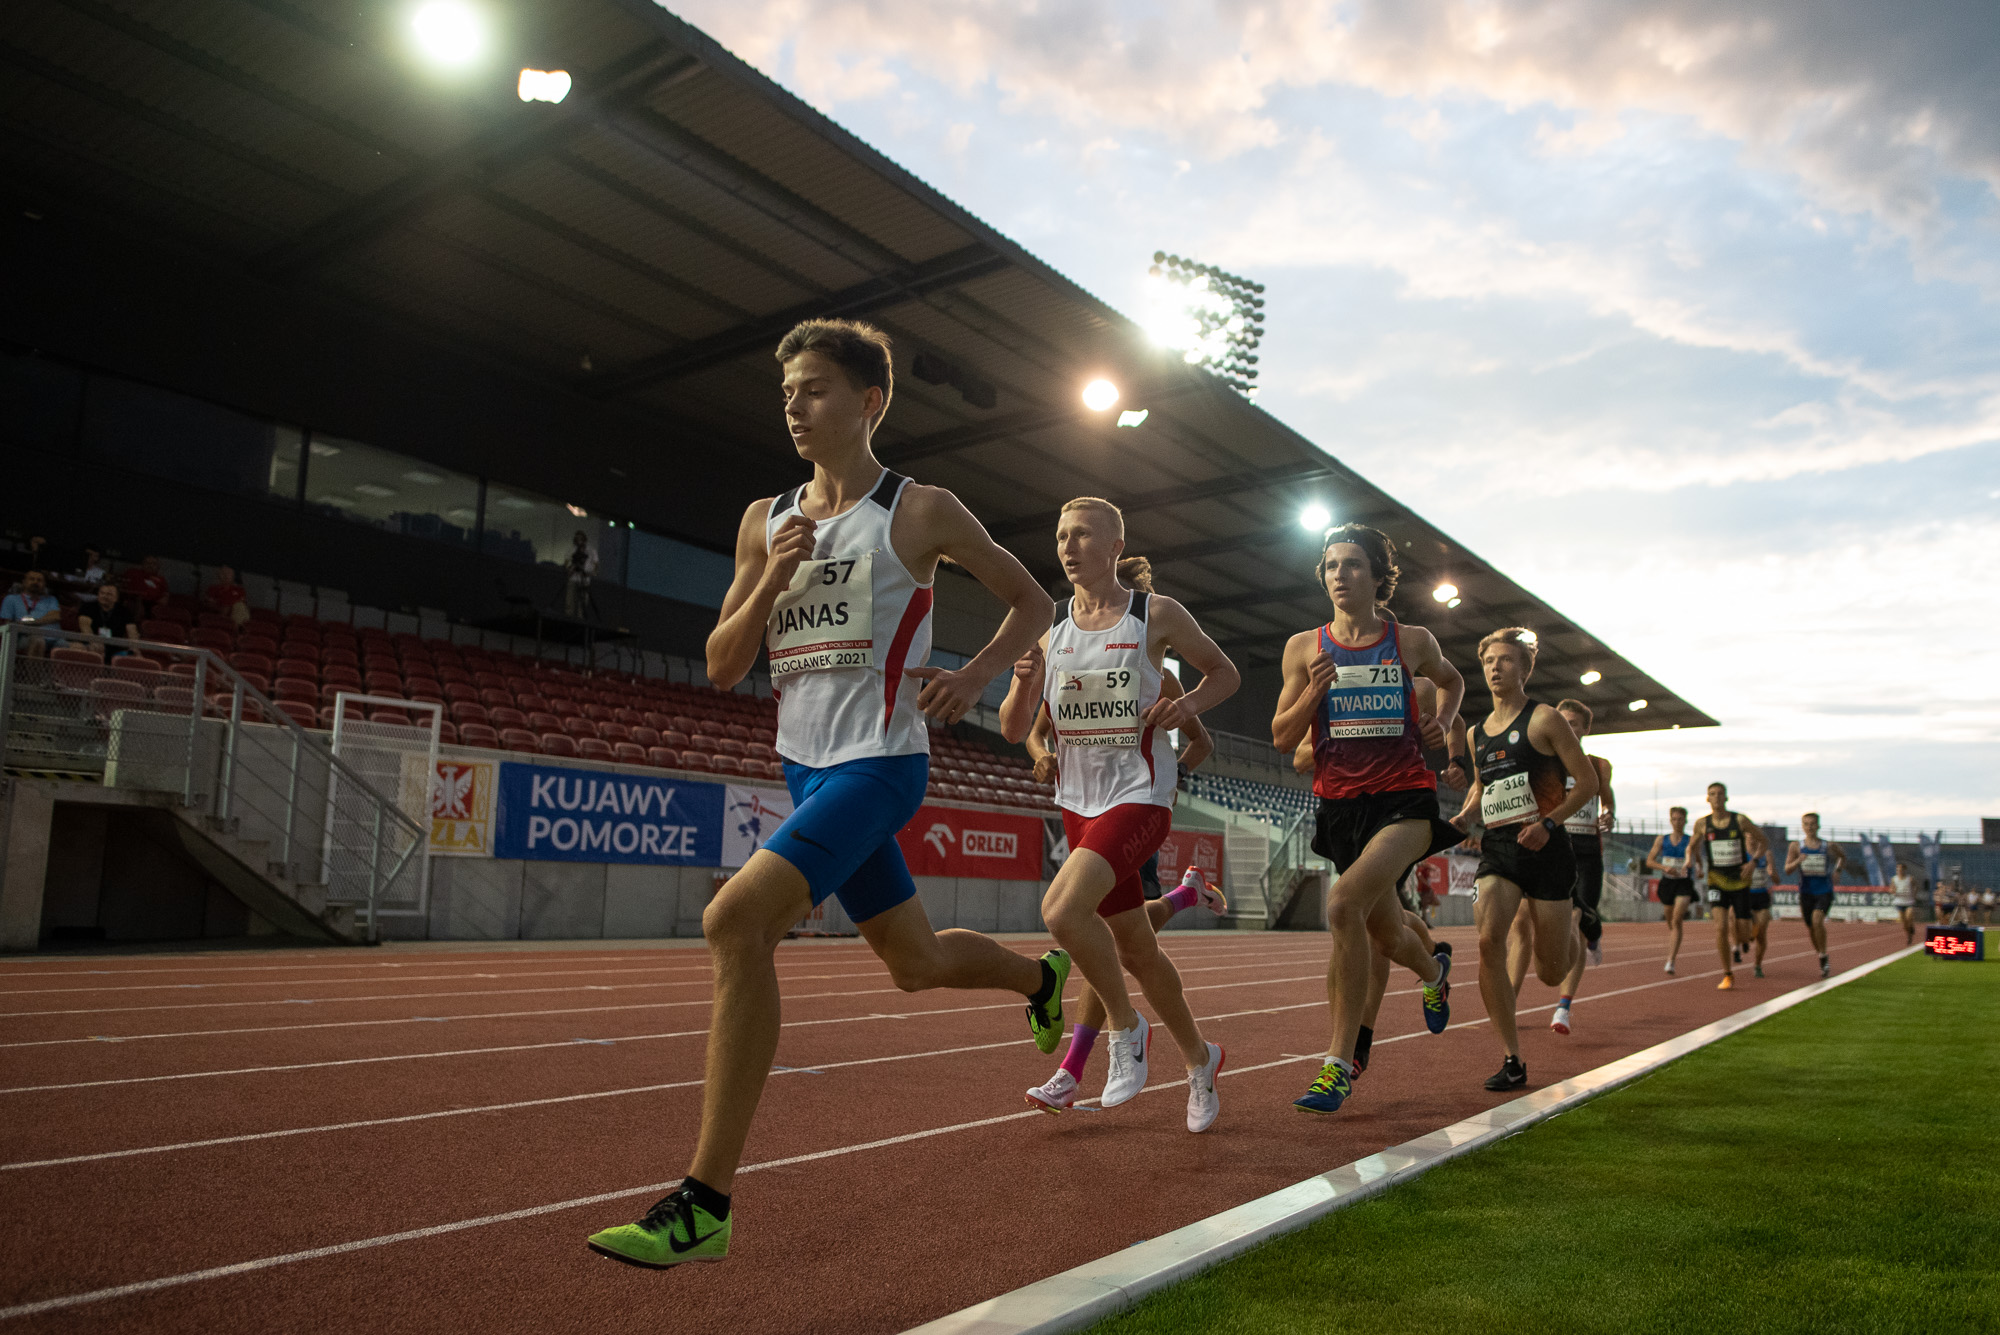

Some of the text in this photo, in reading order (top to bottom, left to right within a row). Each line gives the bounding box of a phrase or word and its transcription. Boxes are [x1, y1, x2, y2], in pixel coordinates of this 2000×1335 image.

[822, 559, 856, 586] 57
[777, 601, 849, 635] JANAS
[771, 652, 867, 674] WŁOCŁAWEK 2021
[1106, 670, 1131, 689] 59
[1369, 667, 1399, 684] 713
[1058, 700, 1139, 721] MAJEWSKI
[1331, 691, 1402, 713] TWARDOŃ
[1064, 737, 1118, 746] WŁOCŁAWEK
[1334, 726, 1401, 736] WŁOCŁAWEK 2021
[1503, 775, 1526, 791] 318
[531, 774, 675, 817] KUJAWY
[1483, 793, 1535, 817] KOWALCZYK
[527, 815, 698, 857] POMORZE
[966, 834, 1014, 854] ORLEN
